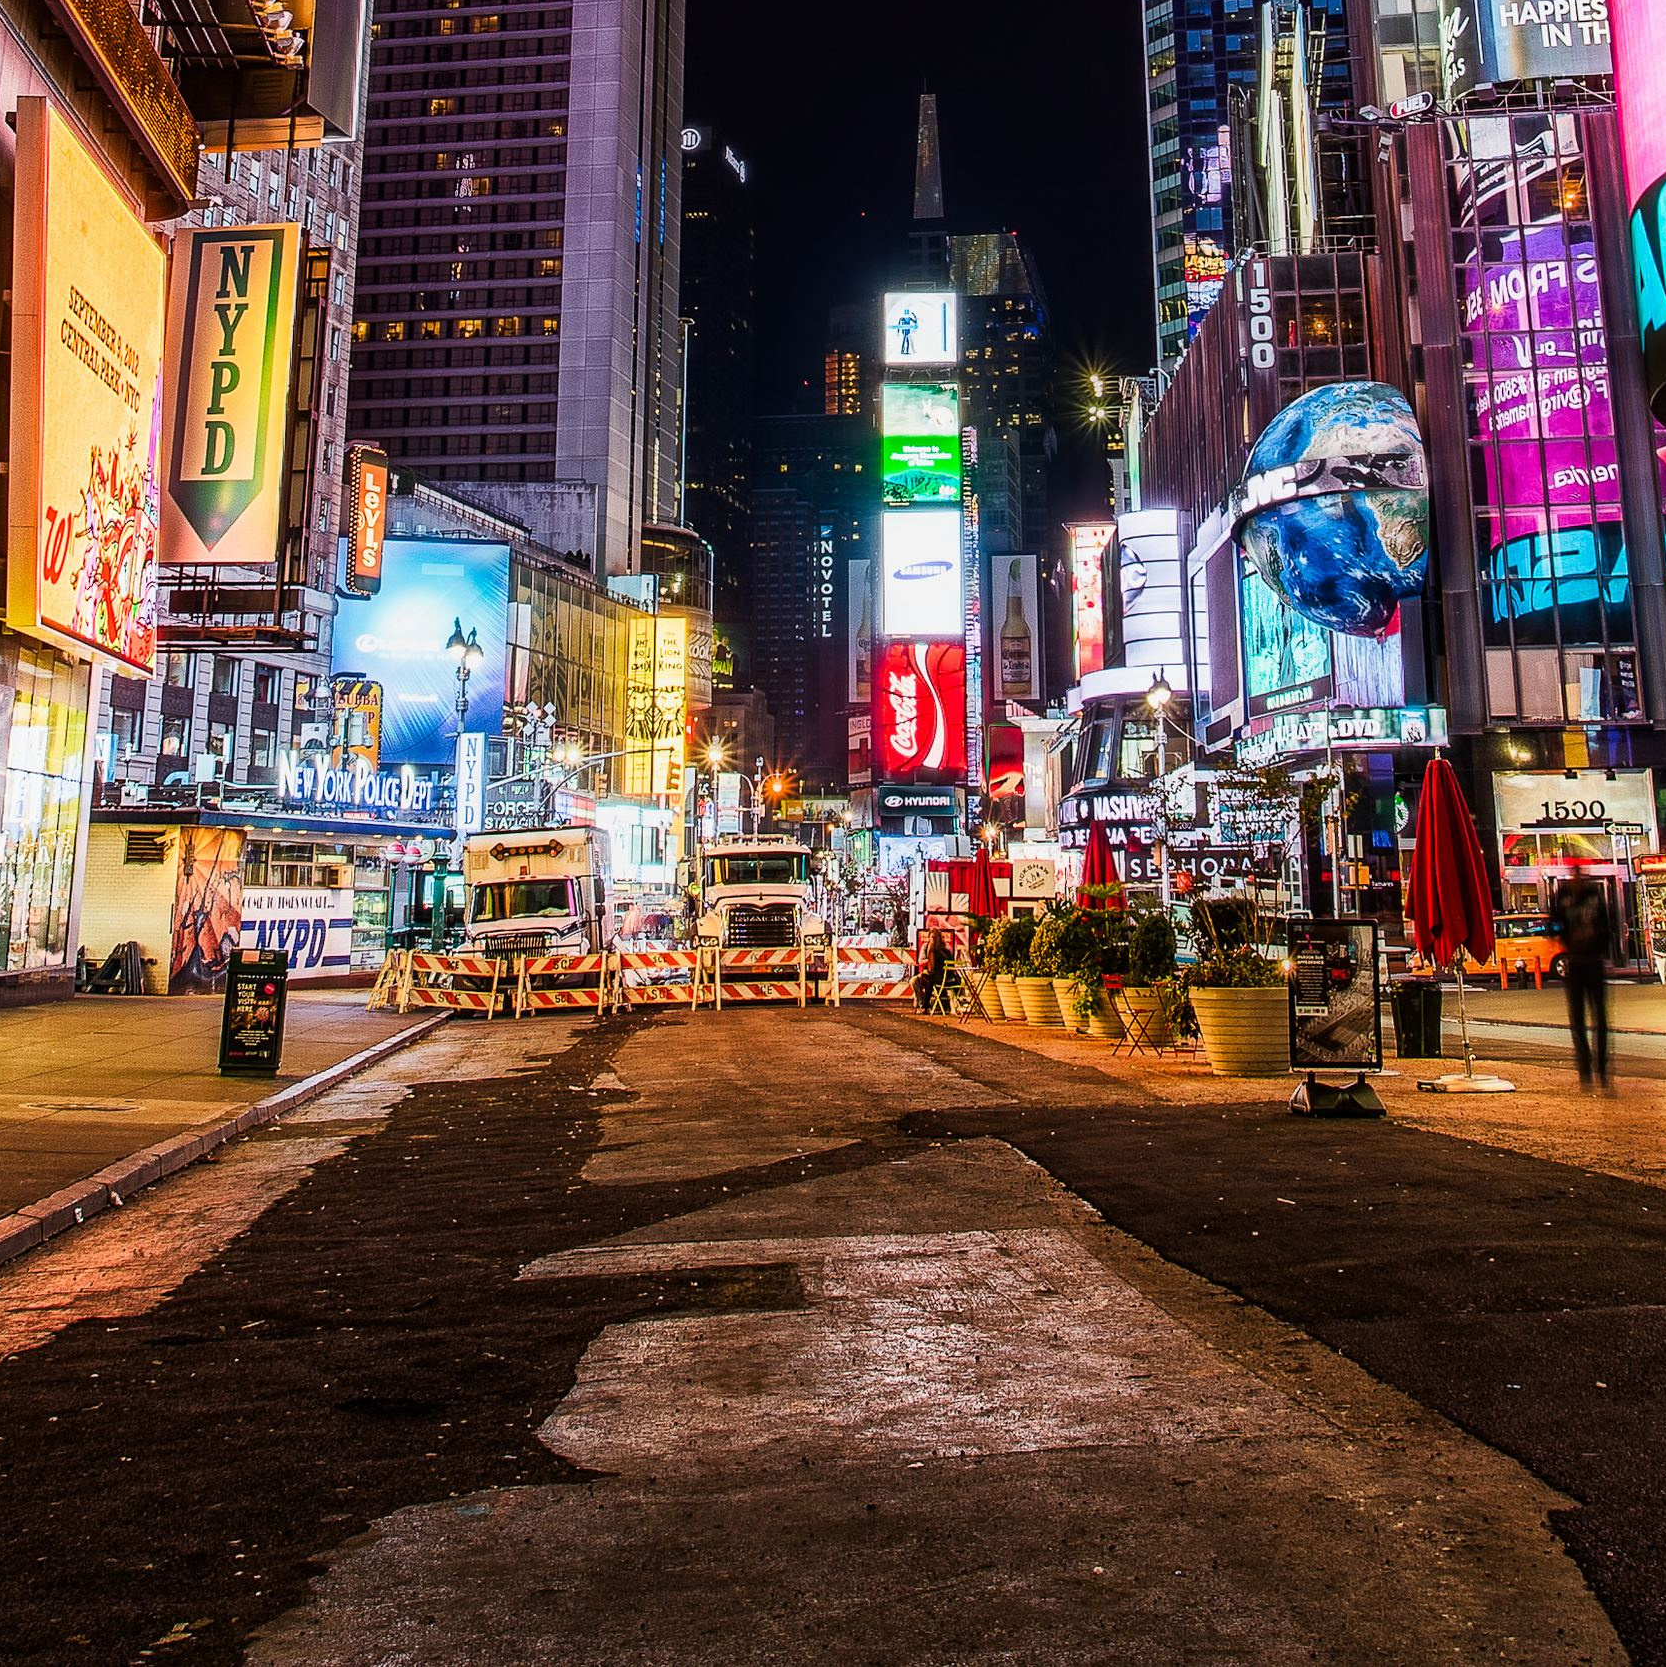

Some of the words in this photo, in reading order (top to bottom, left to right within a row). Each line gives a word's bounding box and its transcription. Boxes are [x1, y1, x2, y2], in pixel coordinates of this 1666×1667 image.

[1541, 22, 1573, 49] IN
[1393, 95, 1430, 118] FUEL
[1251, 262, 1274, 369] 1500
[69, 285, 116, 355] SEPTEMBER
[124, 344, 139, 378] 2012
[61, 318, 100, 375] CENTRAL
[100, 357, 122, 396] PARK
[125, 381, 141, 413] NYC
[200, 245, 255, 477] NYPD
[901, 565, 947, 575] SAMSUNG
[821, 540, 834, 638] NOVOTEL
[659, 660, 683, 672] KING
[660, 649, 680, 658] LION
[1337, 719, 1382, 738] DVD
[464, 737, 478, 825] NYPD
[904, 796, 950, 808] HYUNDAI
[1541, 800, 1606, 821] 1500
[257, 919, 327, 969] NYPD
